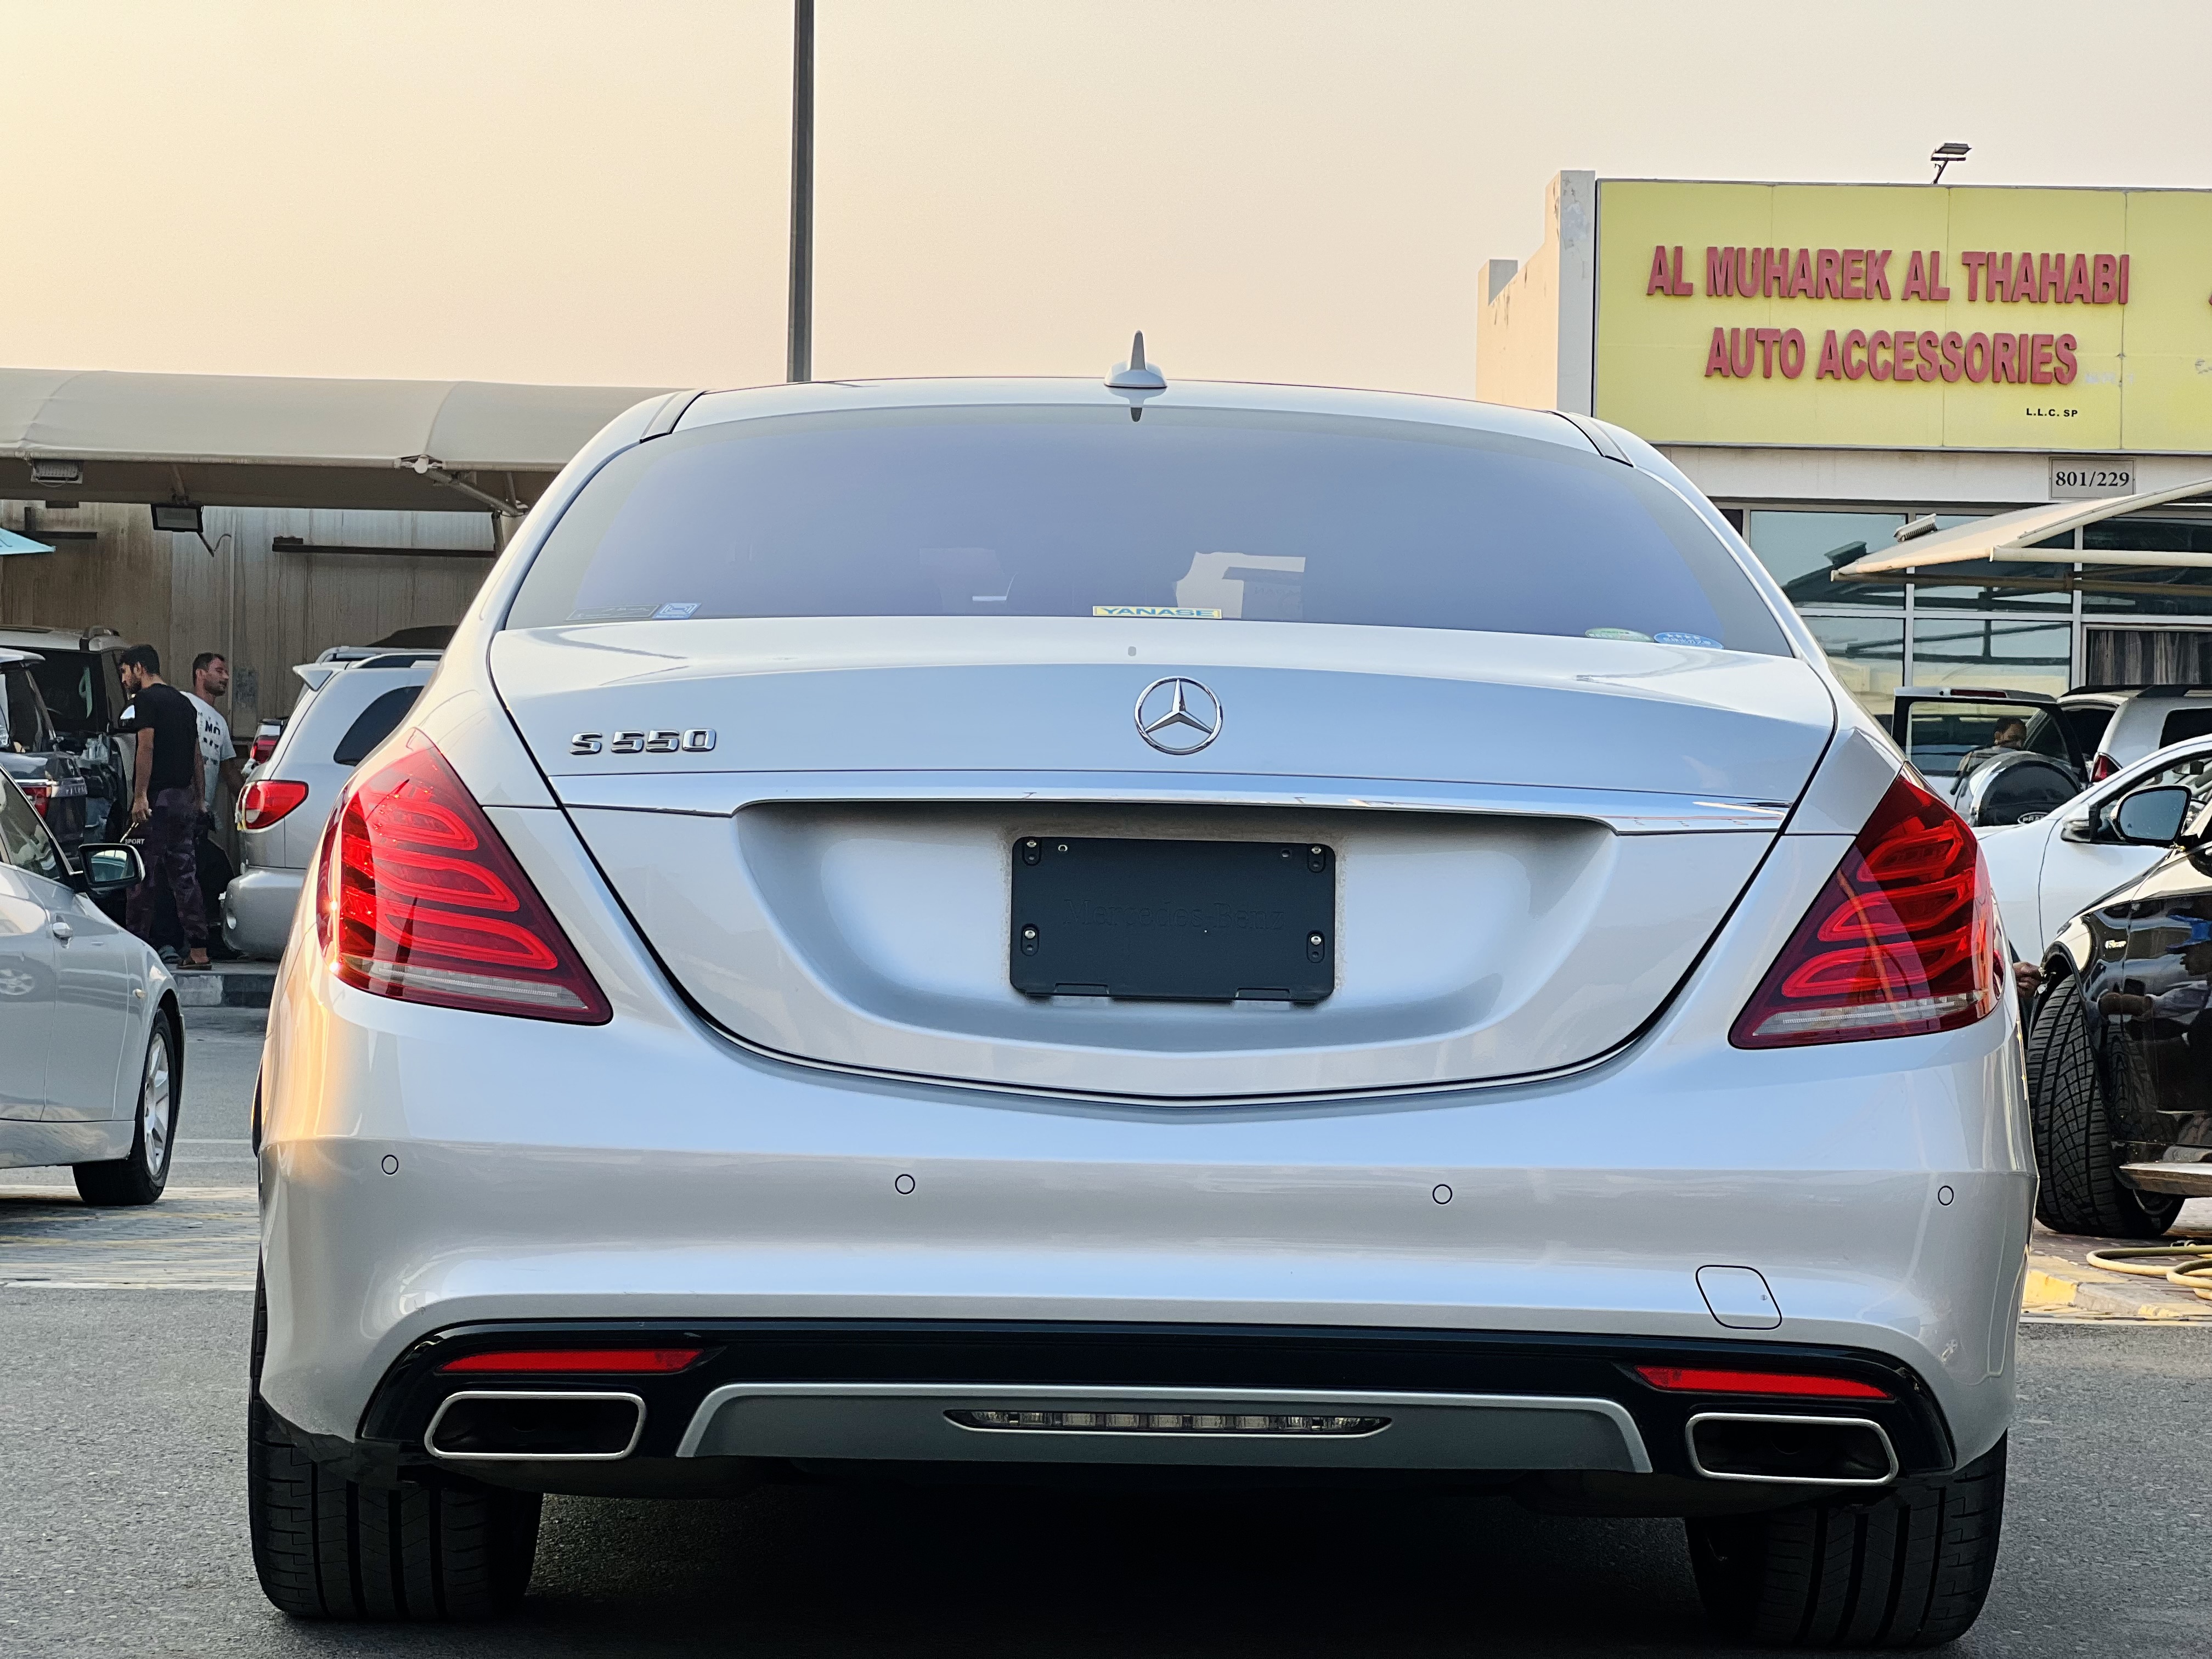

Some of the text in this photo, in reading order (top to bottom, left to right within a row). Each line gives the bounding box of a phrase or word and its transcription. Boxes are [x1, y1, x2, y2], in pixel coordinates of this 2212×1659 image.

[1646, 245, 2130, 304] AL MUHAREK AL THAHABI
[1705, 327, 2078, 385] AUTO ACCESSORIES
[2026, 408, 2059, 417] L.L.C.
[2055, 471, 2130, 487] 801/229
[1102, 608, 1214, 616] YANASE
[569, 729, 716, 755] S 550
[1063, 899, 1285, 930] Mercedes-Benz
